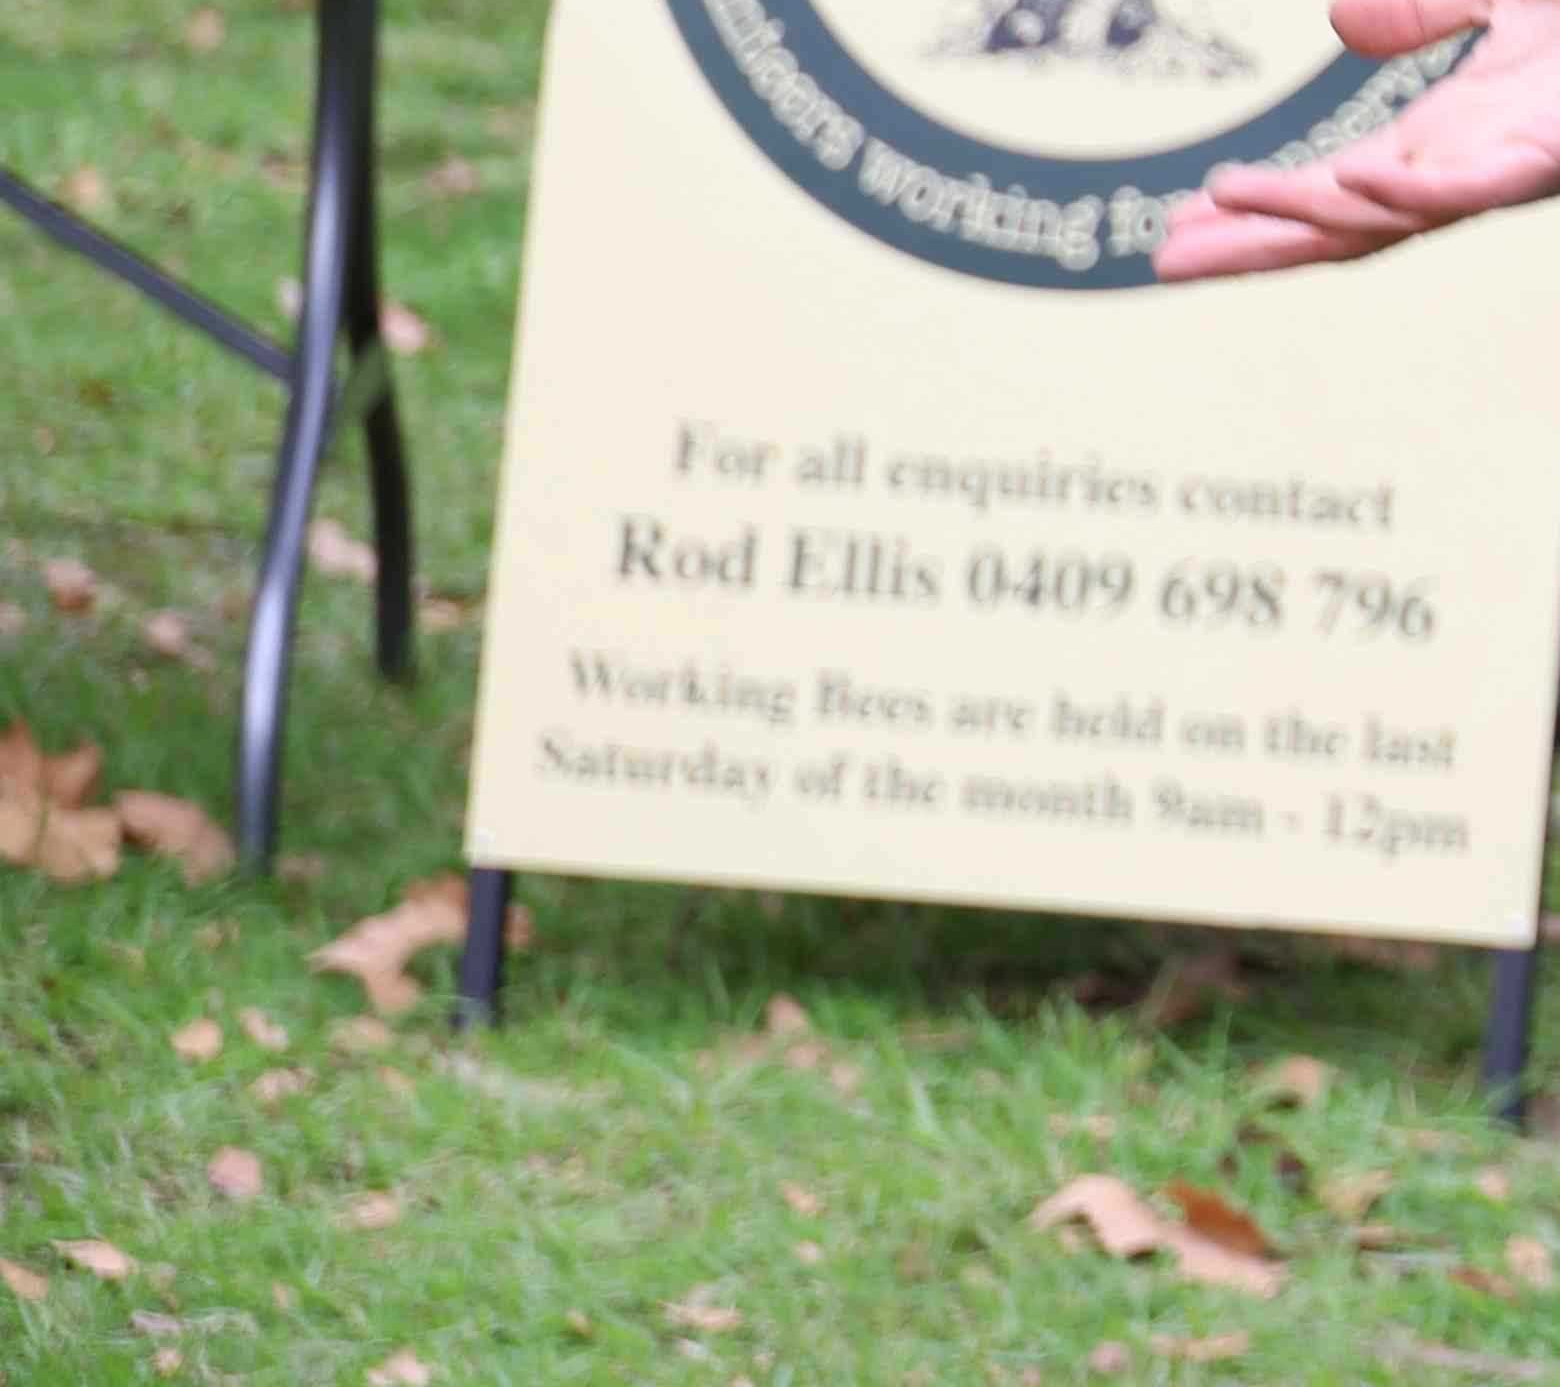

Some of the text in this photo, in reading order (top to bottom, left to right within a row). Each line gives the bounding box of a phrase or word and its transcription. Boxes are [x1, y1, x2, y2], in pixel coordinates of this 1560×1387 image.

[672, 417, 1397, 531] For all enquiries contact
[614, 511, 1440, 645] Rod Ellis 0409 698 796
[568, 647, 1457, 771] Working Bees are held on the last
[532, 727, 774, 815] Saturday
[793, 749, 854, 803] of
[862, 754, 947, 809] the
[958, 769, 1135, 829] month
[1148, 777, 1270, 843] 9am
[1320, 789, 1472, 865] 12pm
